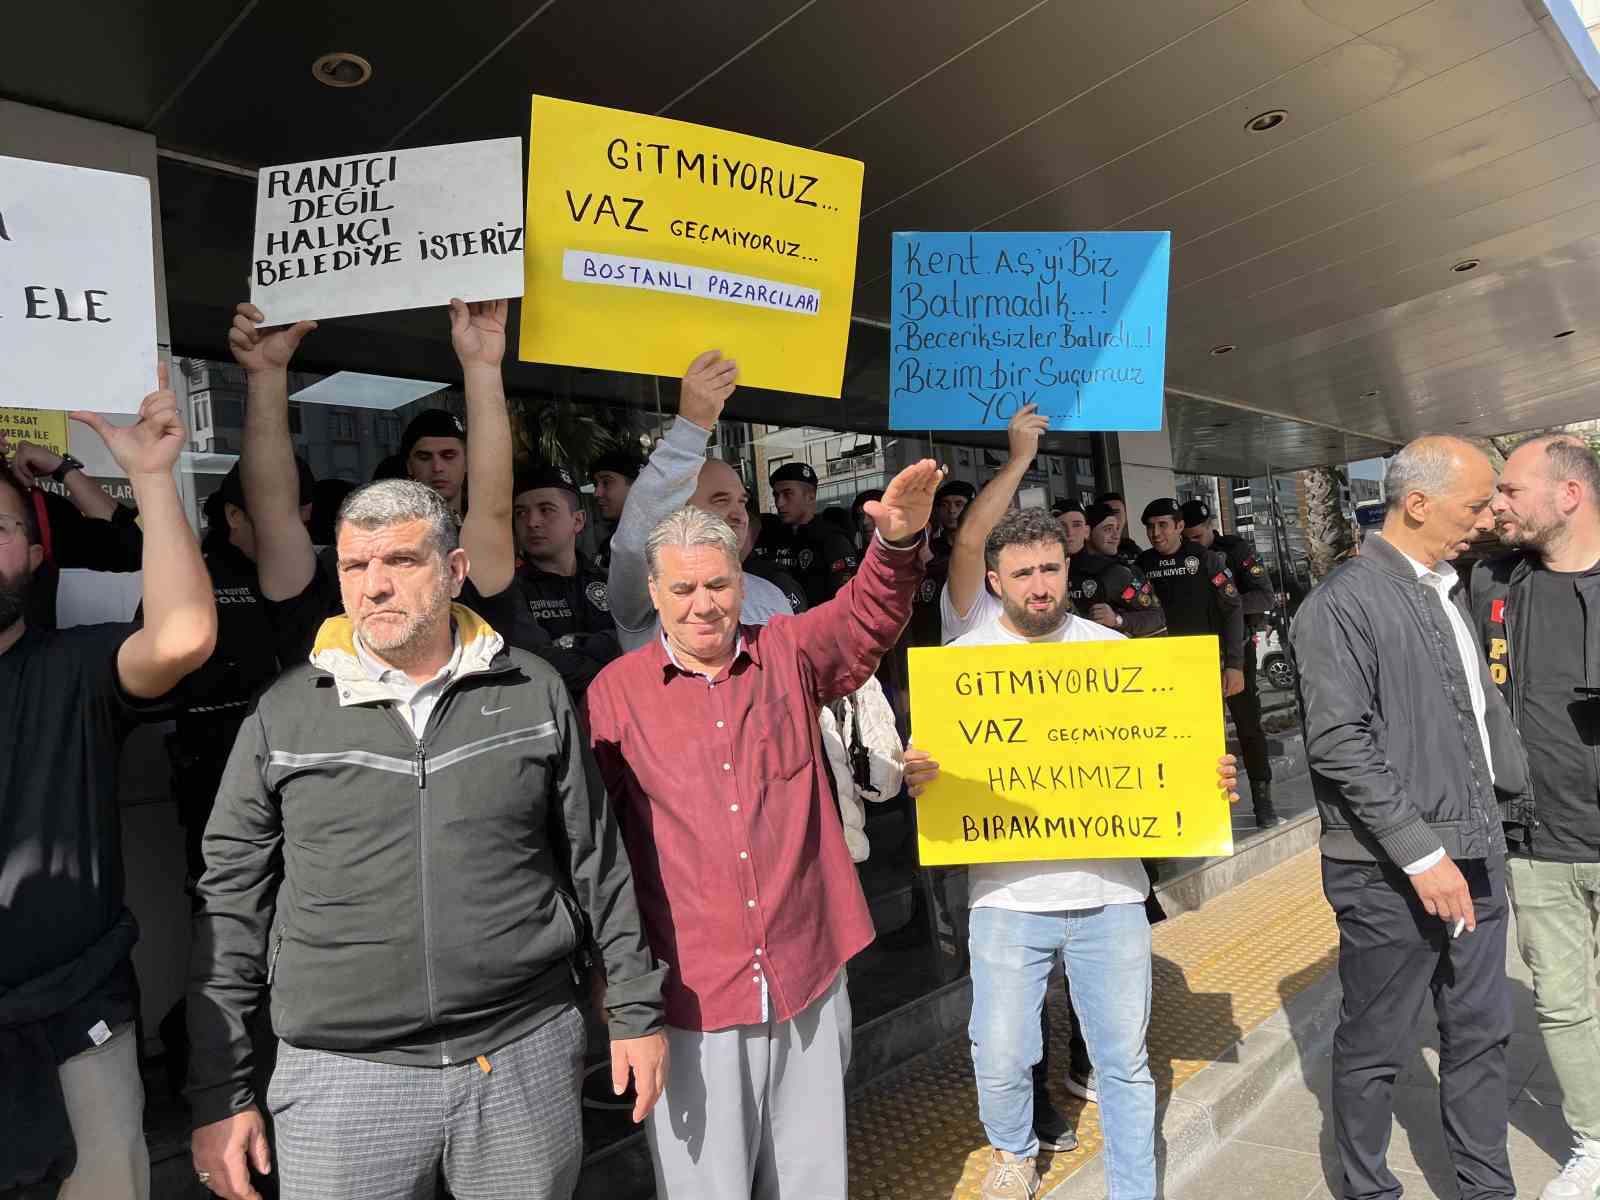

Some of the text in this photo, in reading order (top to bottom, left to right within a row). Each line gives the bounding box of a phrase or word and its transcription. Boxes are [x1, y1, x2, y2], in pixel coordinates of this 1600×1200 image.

[267, 156, 398, 199] RANTÇI
[288, 186, 395, 224] DEĞİL
[565, 189, 649, 233] VAZ
[255, 220, 525, 287] BELEDİYE İSTERİZ
[265, 217, 393, 257] HALKÇI
[1065, 236, 1120, 278] Biz
[23, 284, 113, 324] ELE
[583, 258, 820, 314] BOSTANLI PAZARCILARI
[895, 321, 1057, 354] Beceriksizler
[894, 356, 994, 398] Bizim
[989, 356, 1031, 390] bir
[957, 717, 1028, 745] VAZ
[987, 765, 1144, 793] HAKKIMIZI
[961, 813, 1162, 843] BIRAKMIYORUZ
